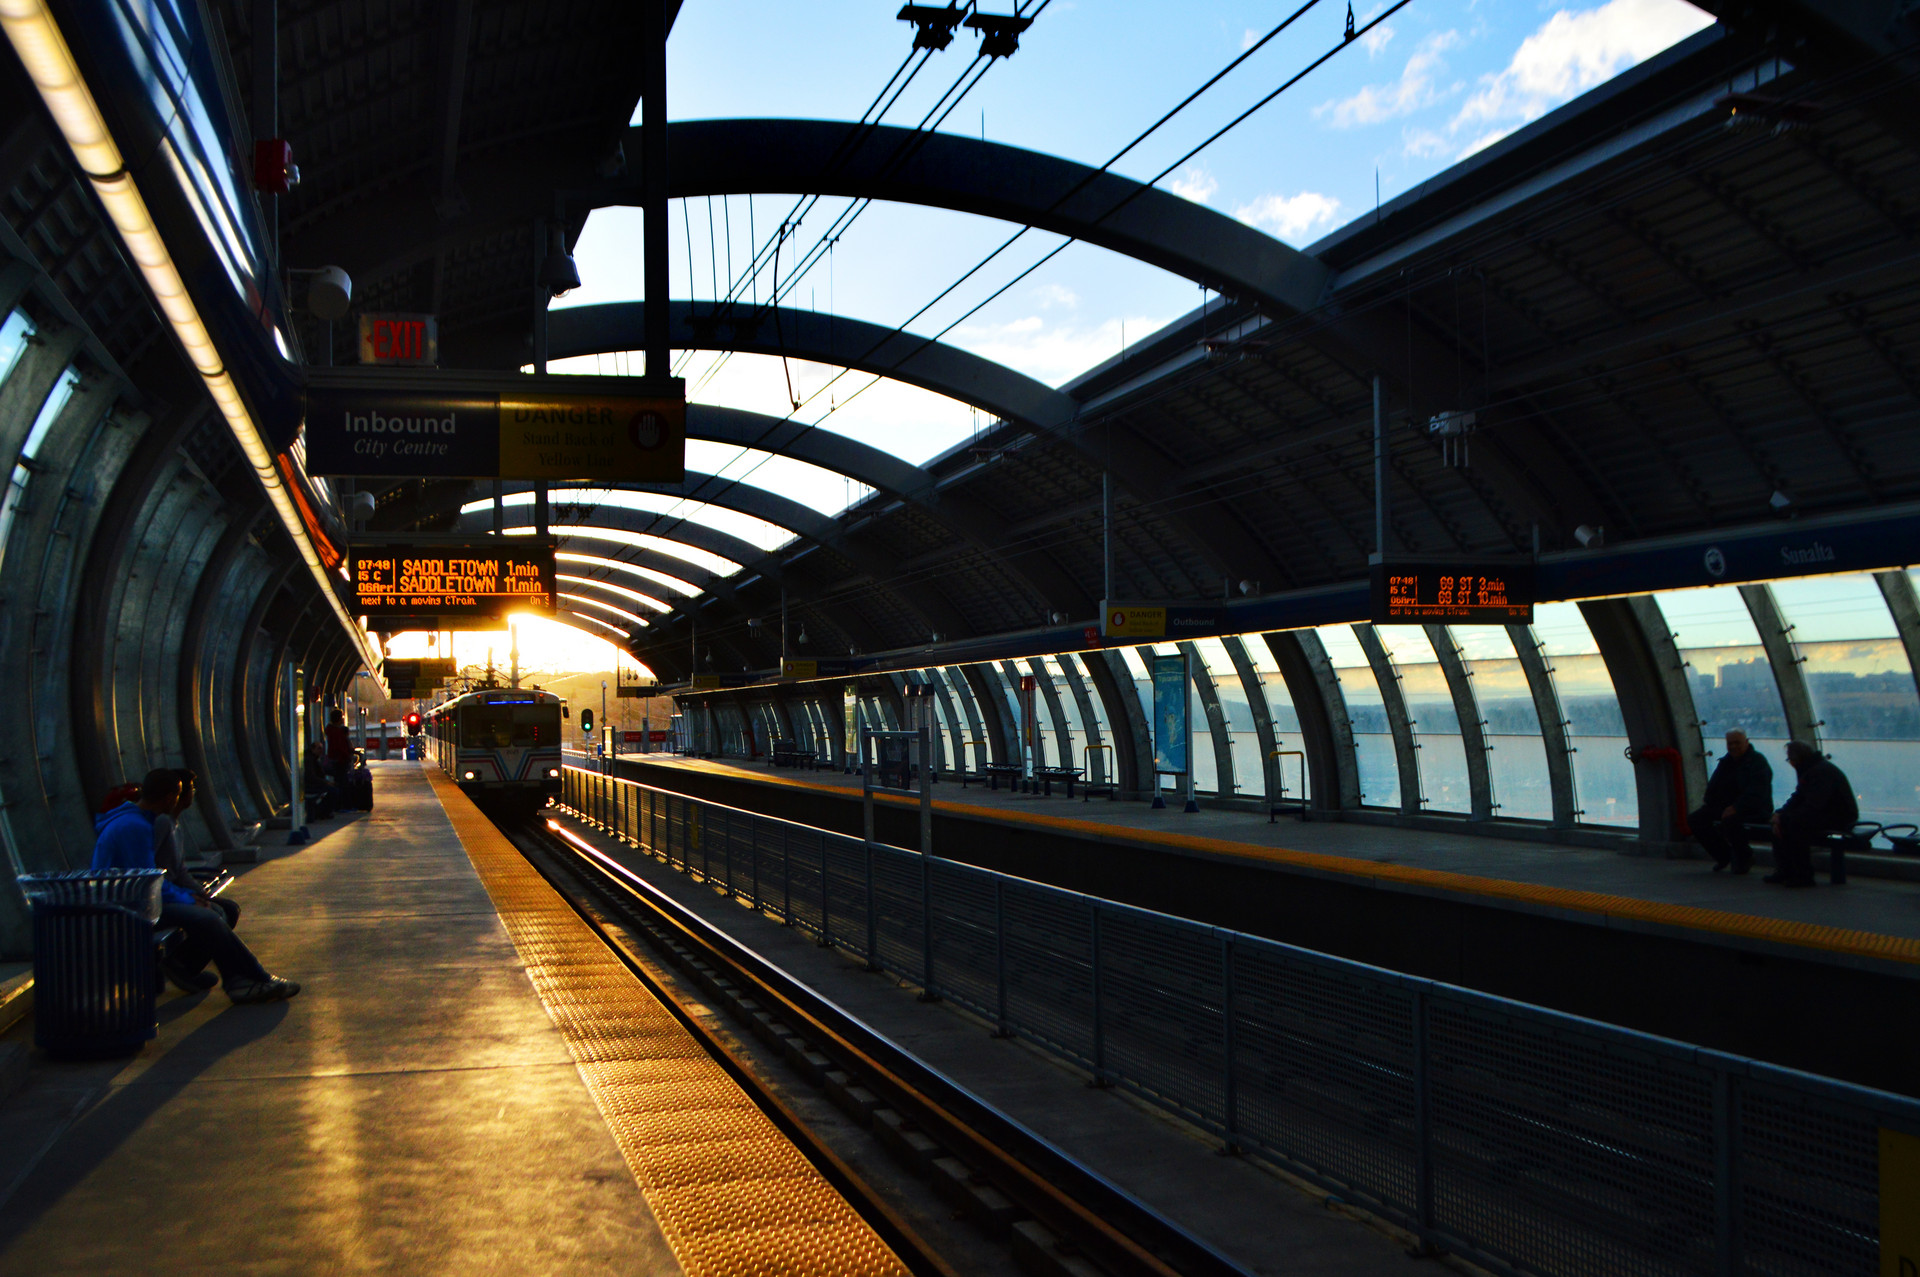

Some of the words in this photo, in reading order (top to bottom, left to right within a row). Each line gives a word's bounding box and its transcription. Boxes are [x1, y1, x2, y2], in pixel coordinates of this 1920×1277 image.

[374, 320, 426, 359] EXIT
[345, 410, 457, 435] Inbound
[514, 408, 614, 425] DANGER
[522, 432, 560, 445] Stand
[565, 432, 597, 446] Back
[601, 432, 617, 446] of
[353, 438, 388, 458] City
[393, 438, 449, 456] Centre
[538, 452, 581, 466] Yellow
[587, 454, 615, 466] Line
[1780, 541, 1836, 566] Sunalta
[402, 559, 499, 576] SADDLETOWN
[358, 570, 369, 581] 15
[373, 570, 382, 581] C
[358, 582, 393, 592] 06Apr
[400, 576, 496, 592] SADDLETOWN
[1390, 585, 1398, 594] 15
[1401, 585, 1407, 594] C
[1440, 576, 1454, 591] 69
[1459, 576, 1473, 591] ST
[361, 595, 381, 605] next
[386, 595, 396, 605] to
[411, 596, 441, 606] moving
[445, 596, 477, 606] CTrain.
[1438, 590, 1452, 605] 69
[1457, 590, 1471, 605] ST
[1173, 617, 1215, 626] Outbound
